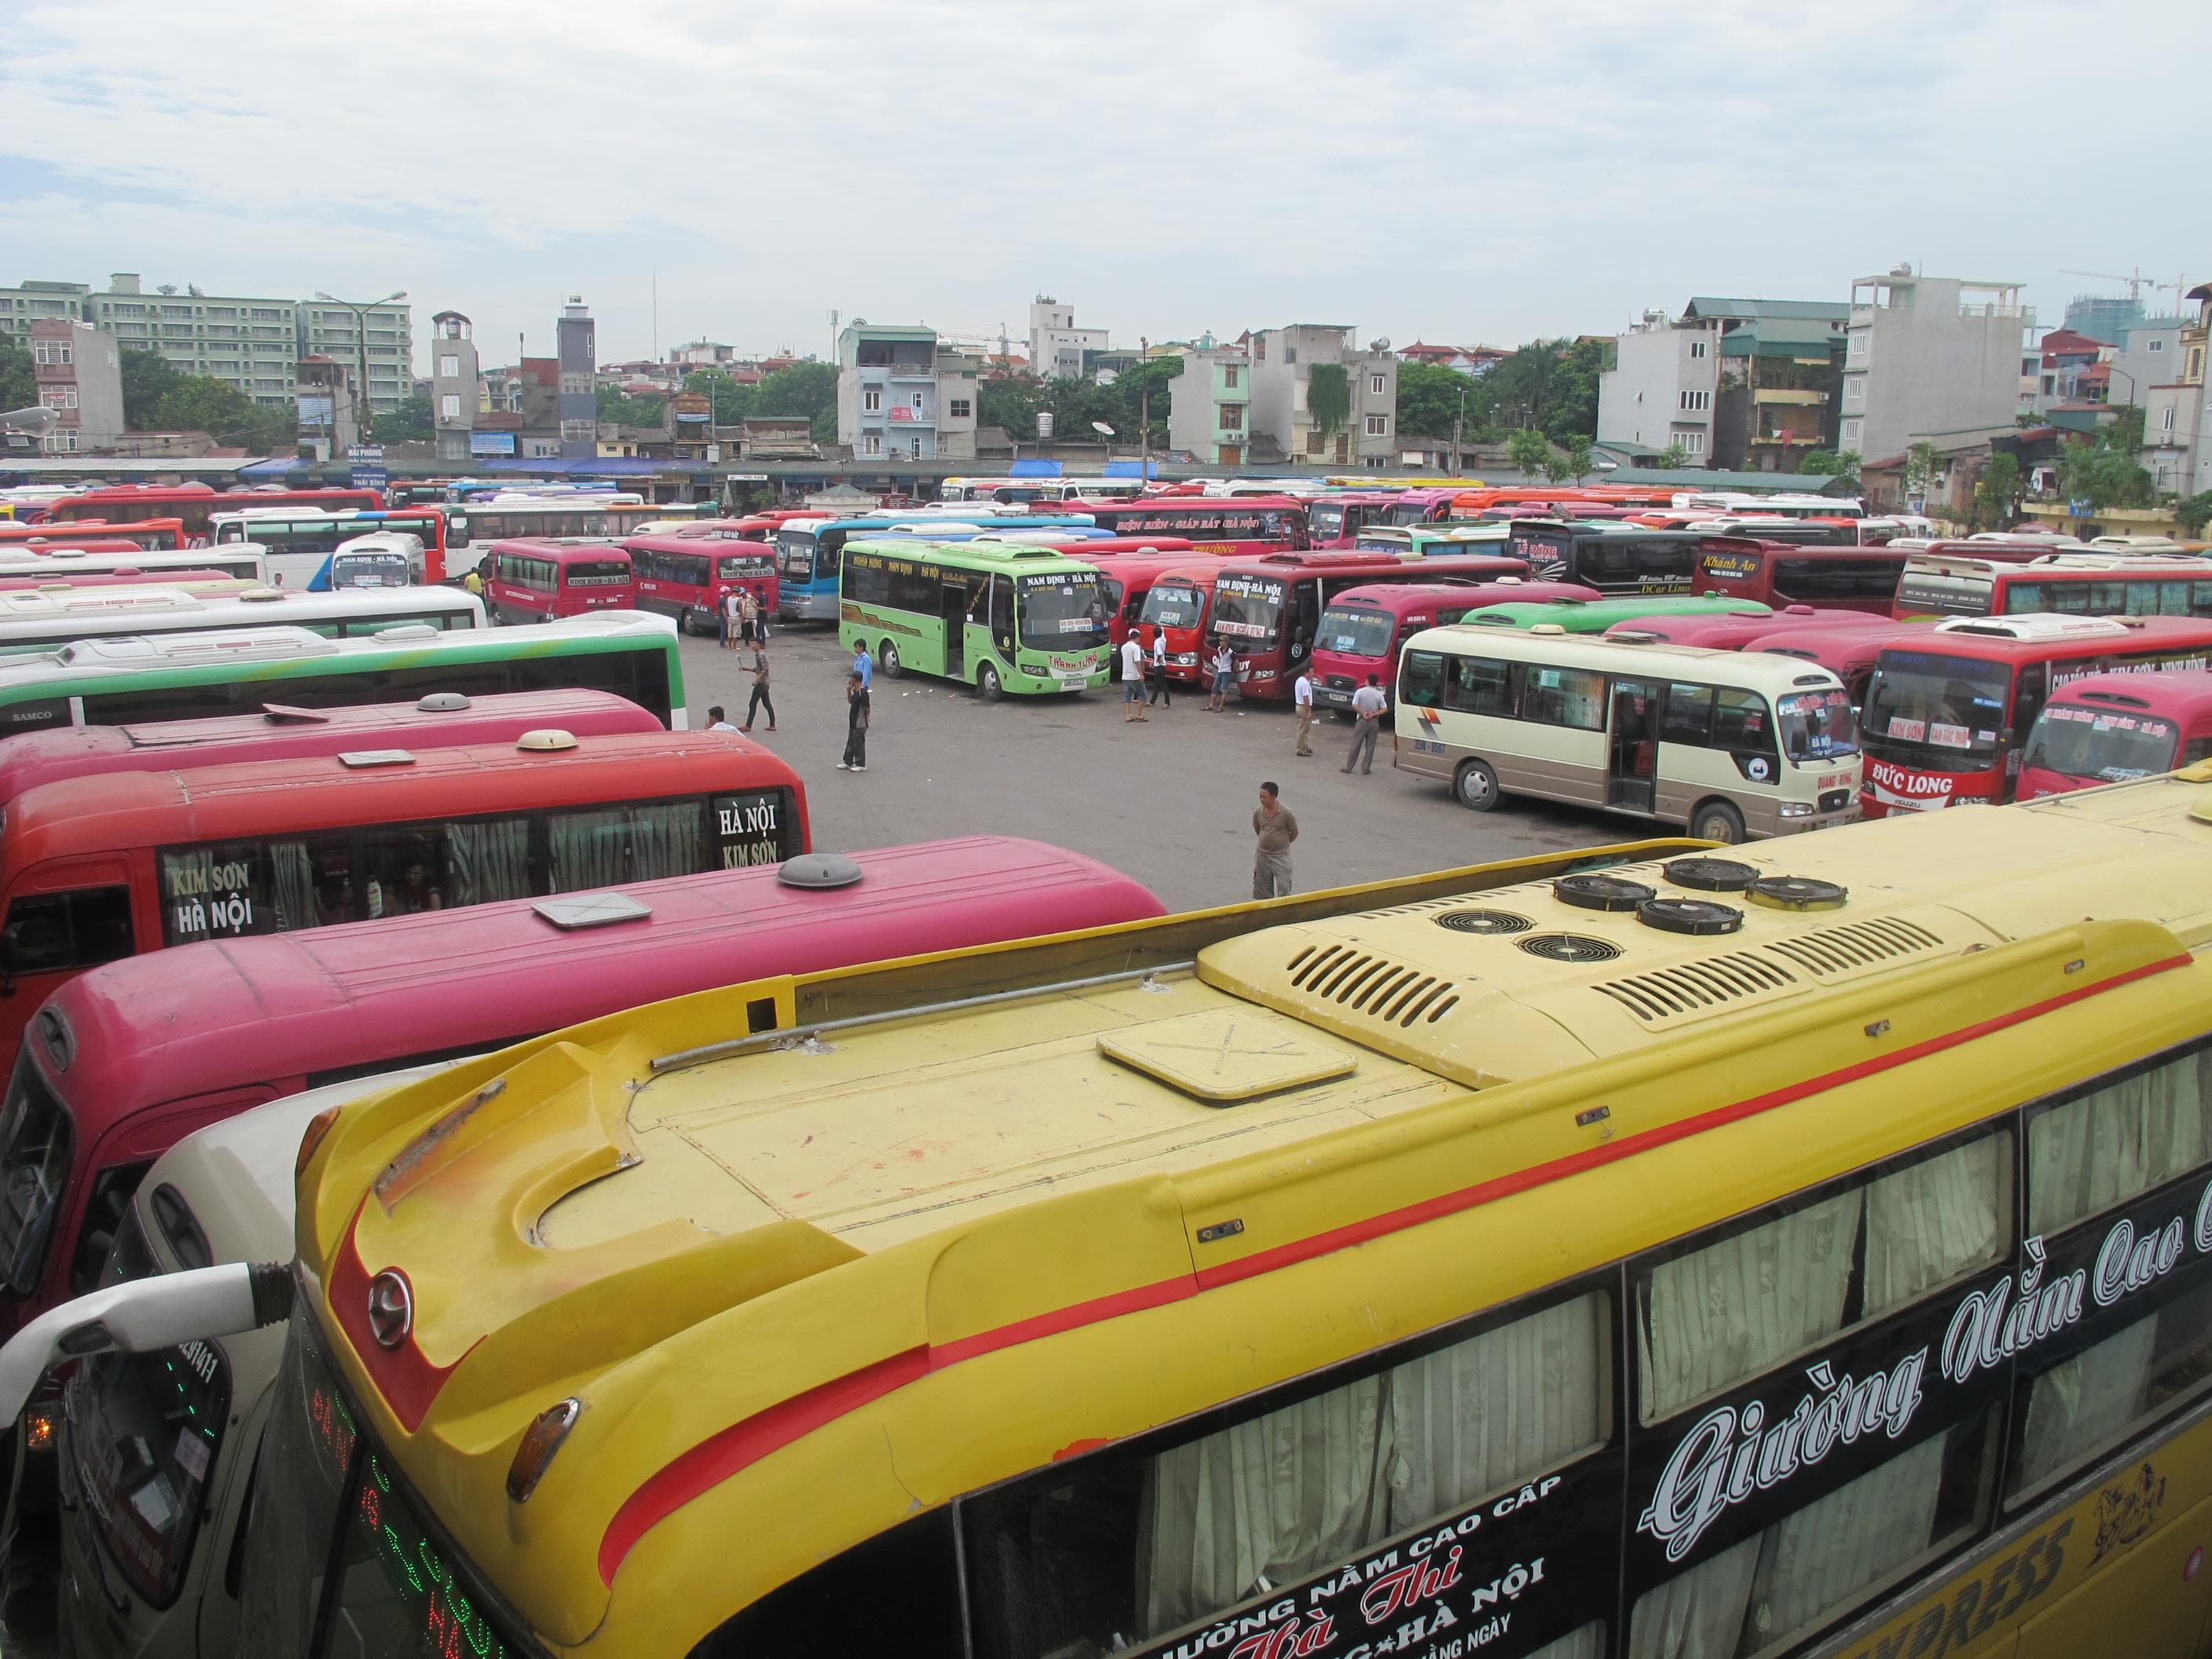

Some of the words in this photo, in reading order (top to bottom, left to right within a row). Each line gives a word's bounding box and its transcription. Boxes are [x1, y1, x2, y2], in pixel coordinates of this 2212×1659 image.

[1174, 518, 1199, 529] GIÁP
[1200, 517, 1221, 529] BÁT
[1703, 555, 1737, 569] Khánh
[1738, 559, 1756, 571] An
[1027, 576, 1046, 586] NAM
[1046, 575, 1066, 585] ĐỊNH
[1071, 572, 1083, 583] HÀ
[1083, 573, 1097, 584] NỘI
[1216, 579, 1231, 588] NAM
[1264, 584, 1282, 597] NỘI
[1668, 584, 1691, 594] Limo
[1239, 659, 1251, 671] UY
[13, 711, 53, 721] SAMCO
[1818, 774, 1837, 790] QUANG
[1872, 763, 1905, 789] ĐỨC
[1906, 775, 1954, 794] LONG
[719, 800, 744, 836] HÀ
[745, 797, 777, 838] NỘI
[1895, 799, 1921, 808] ISUZU
[723, 844, 749, 870] KIM
[751, 839, 778, 866] SƠN
[173, 867, 210, 896] KIM
[212, 861, 250, 892] SƠN
[178, 897, 207, 933] HÀ
[211, 892, 253, 933] NỘI
[1636, 1346, 1929, 1563] Giường
[1941, 1235, 2086, 1384] Nằm
[2093, 1216, 2184, 1306] Cao
[1163, 1599, 1295, 1659] ƯỜNG
[1408, 1514, 1481, 1557] CAO
[1492, 1475, 1562, 1517] CẤP
[1360, 1545, 1463, 1624] Thi
[1395, 1599, 1459, 1650] HÀ
[1471, 1557, 1545, 1613] NỘI
[1467, 1612, 1511, 1652] NGÀY
